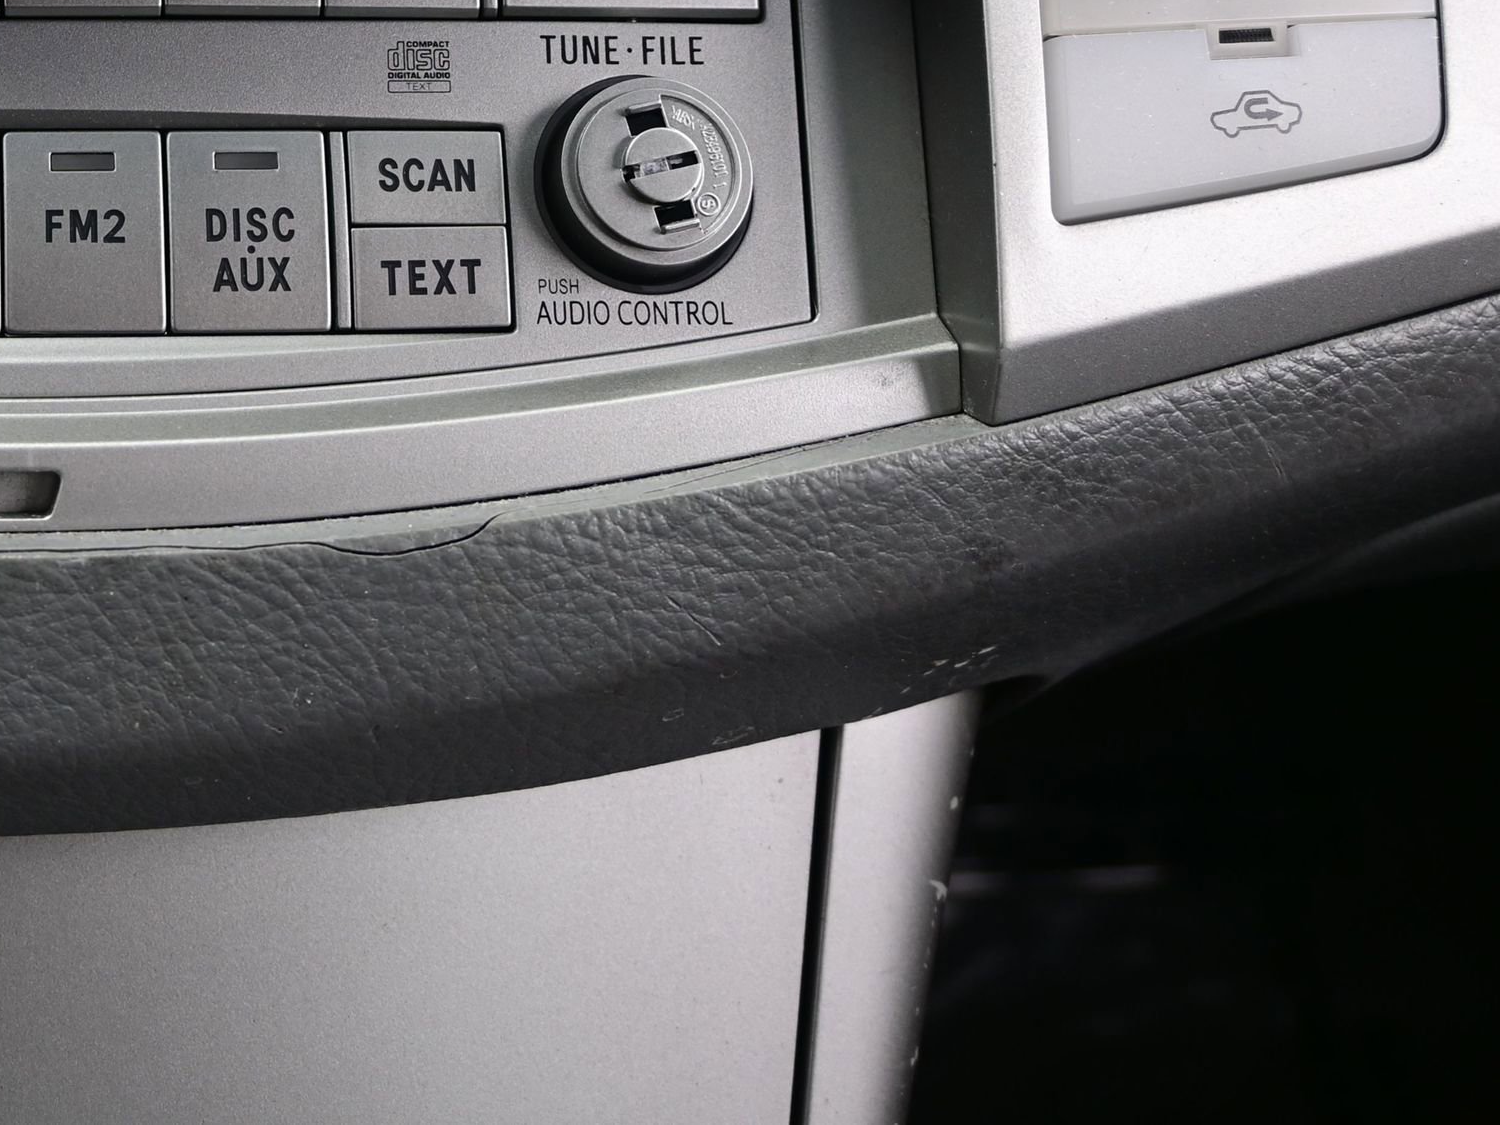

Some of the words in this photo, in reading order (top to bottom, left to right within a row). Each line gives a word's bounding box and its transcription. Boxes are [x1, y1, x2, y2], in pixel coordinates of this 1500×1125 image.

[387, 41, 451, 71] disc
[406, 40, 450, 48] COMPACT
[405, 82, 432, 91] TEXT
[379, 158, 475, 192] SCAN
[46, 209, 125, 243] FM2
[206, 207, 295, 242] DISC
[213, 257, 291, 292] AUX
[381, 259, 481, 295] TEXT
[539, 279, 579, 294] PUSH
[537, 301, 609, 325] AUDIO
[618, 301, 733, 325] CONTROL
